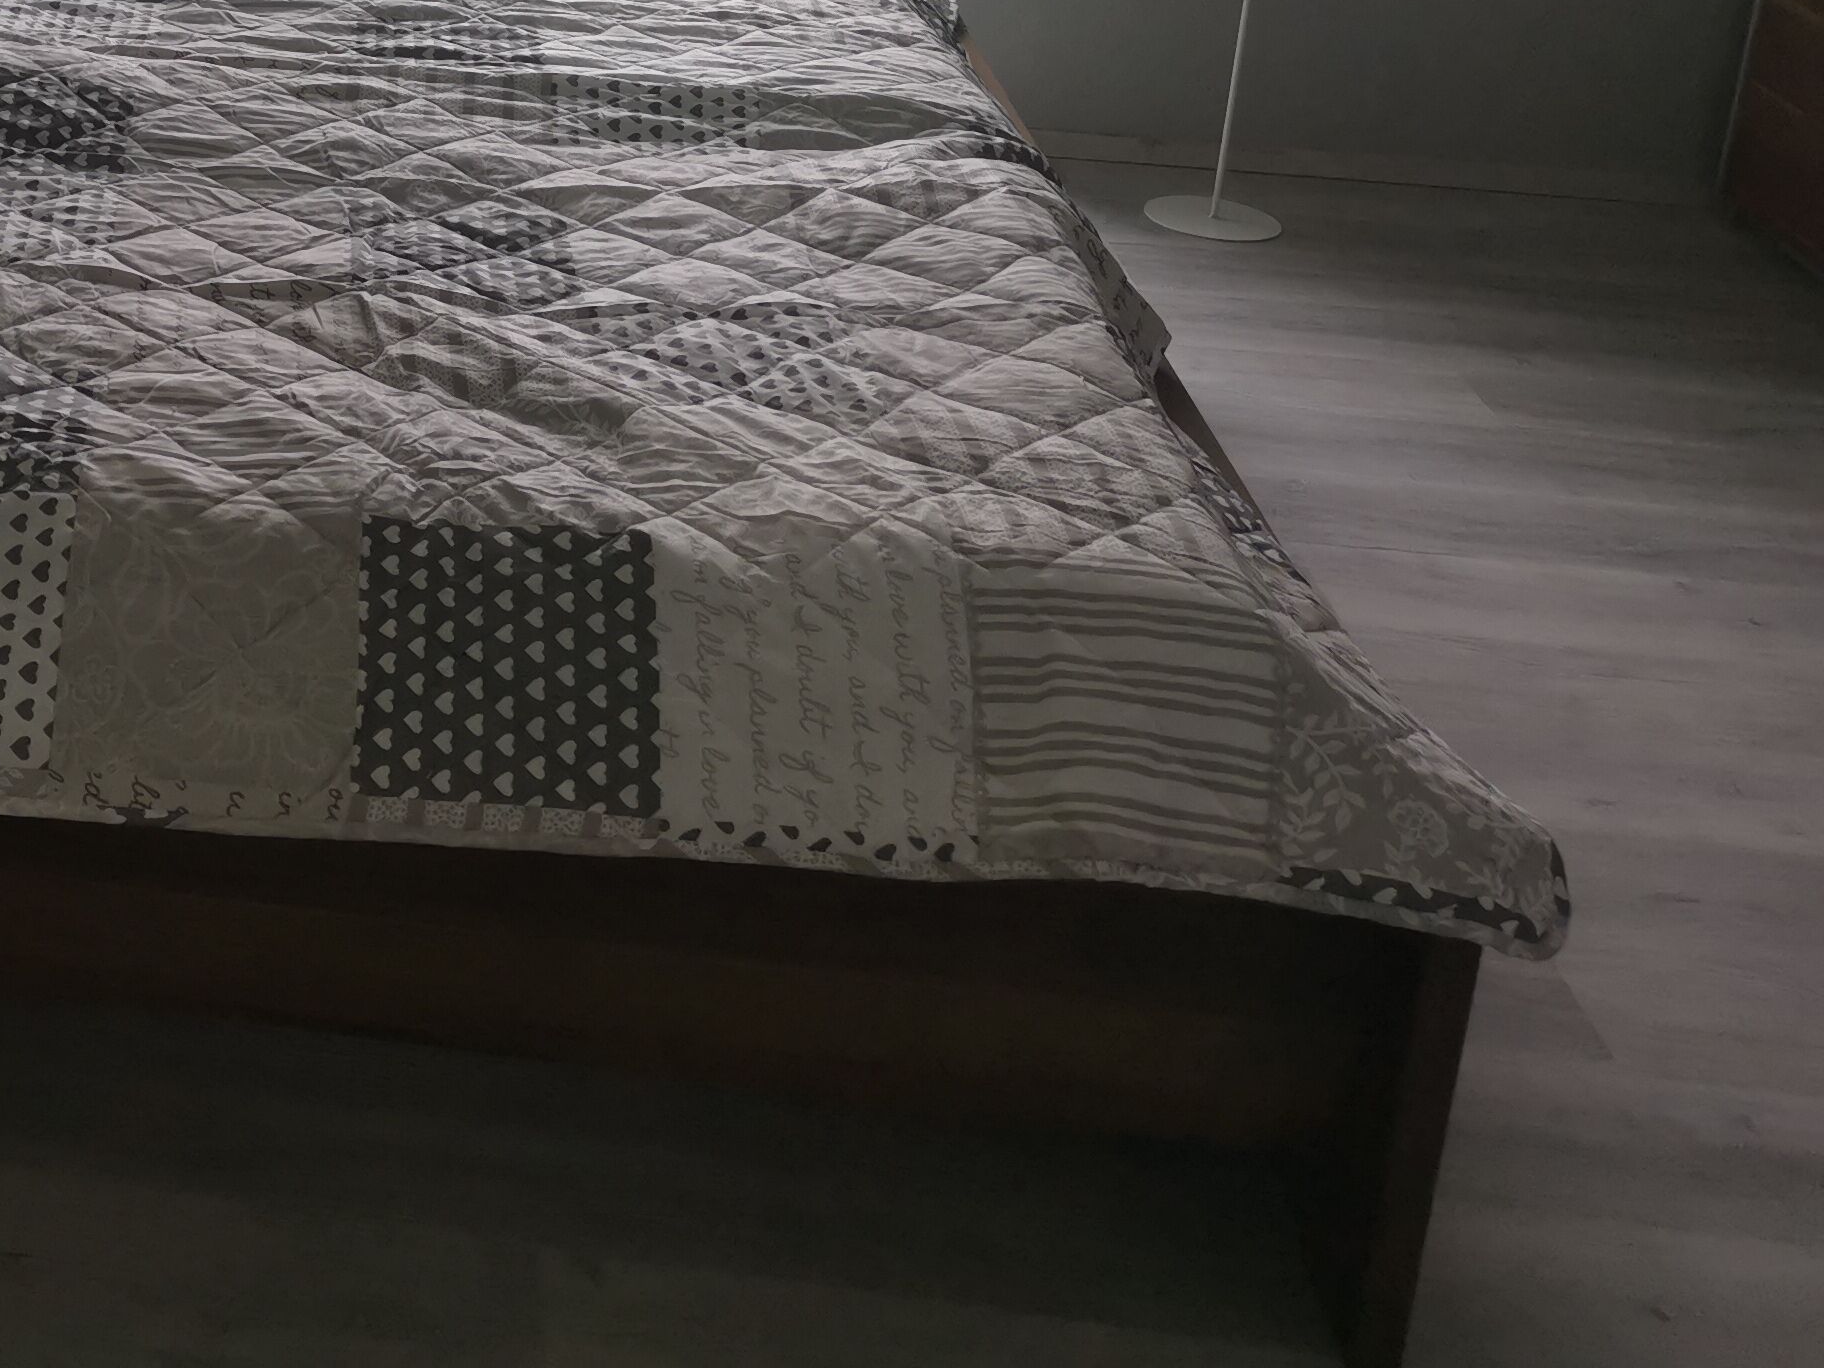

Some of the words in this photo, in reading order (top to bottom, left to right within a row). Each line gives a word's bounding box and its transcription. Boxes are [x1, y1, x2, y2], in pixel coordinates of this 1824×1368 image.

[885, 569, 914, 628] love
[893, 633, 931, 701] with
[669, 589, 725, 705] falling
[701, 747, 731, 817] love
[849, 676, 880, 735] and
